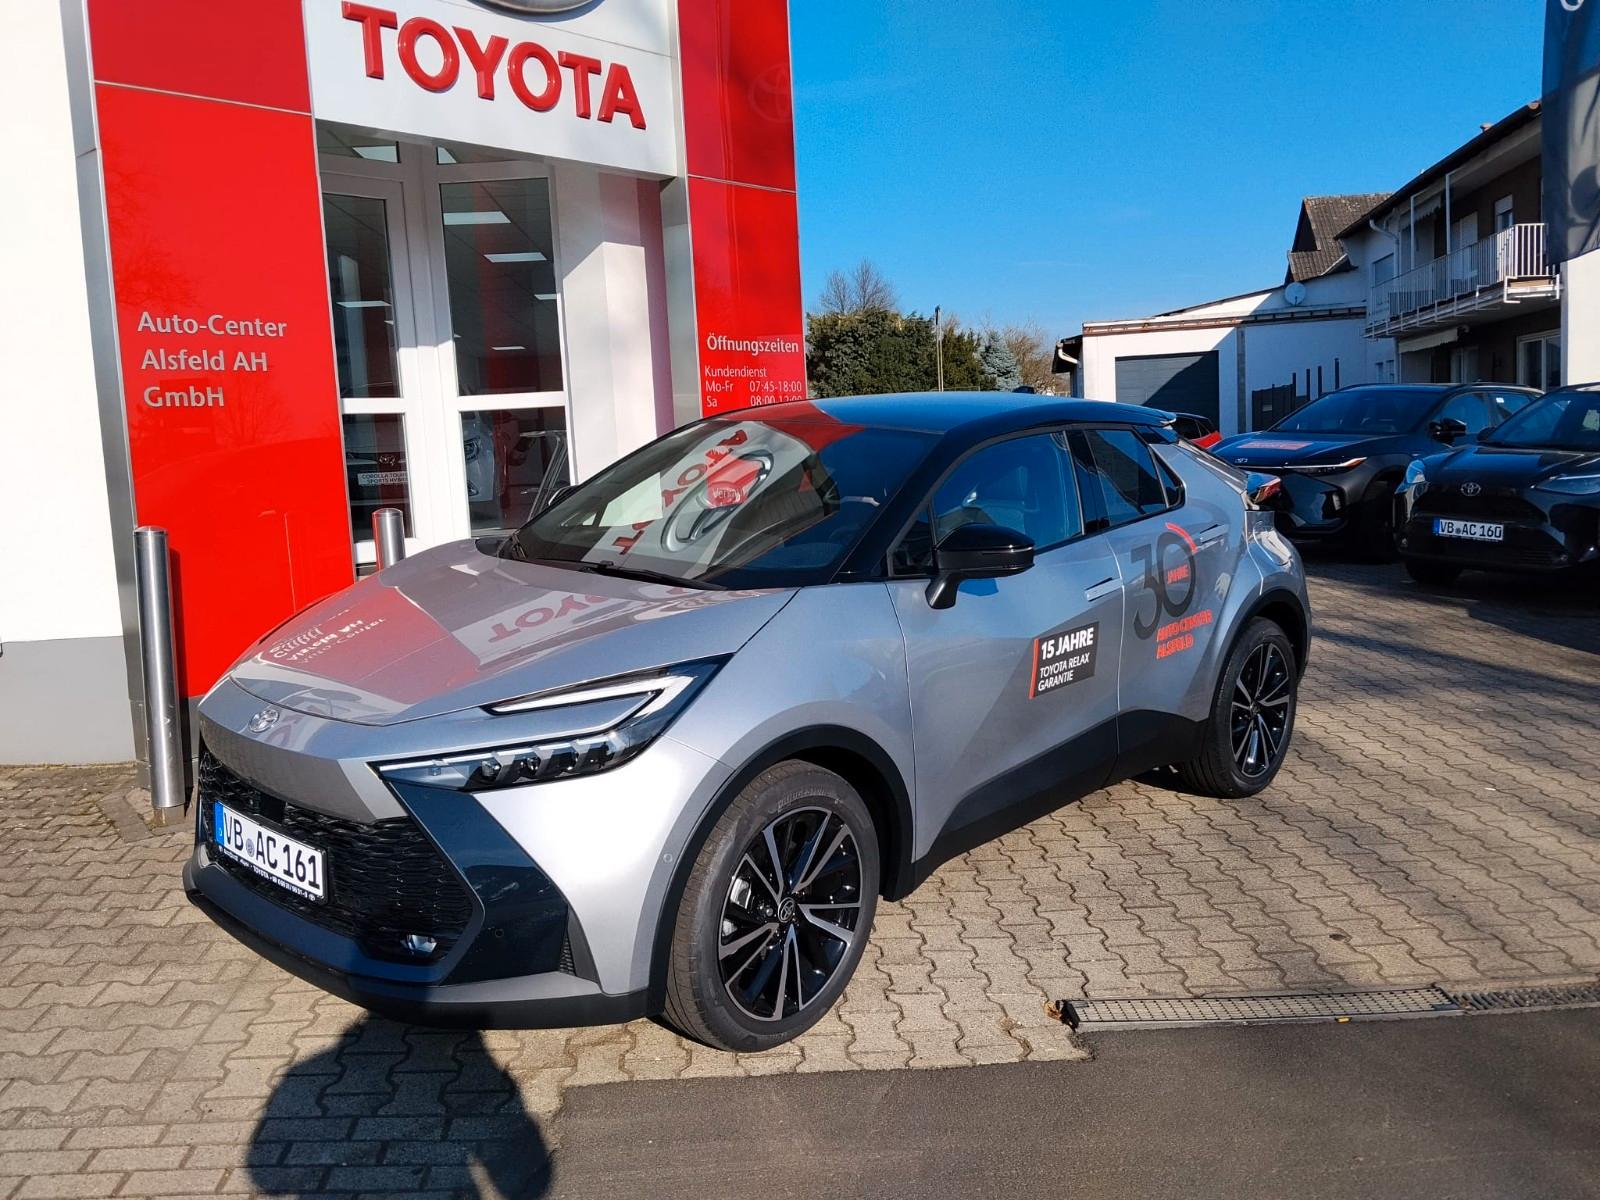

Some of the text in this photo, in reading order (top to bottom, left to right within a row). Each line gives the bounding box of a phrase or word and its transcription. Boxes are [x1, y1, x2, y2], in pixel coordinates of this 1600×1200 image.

[341, 1, 647, 130] TOYOTA
[137, 311, 287, 337] Auto-Center
[706, 332, 799, 356] Öffnungszeiten
[141, 348, 268, 372] Alsfeld AH
[705, 365, 768, 377] Kundendienst
[143, 385, 225, 408] GmbH
[705, 380, 802, 392] Mo-Fr 07:45-18:00
[706, 395, 718, 408] Sa
[1440, 521, 1455, 534] VB
[1462, 523, 1477, 536] AC
[1479, 525, 1502, 538] 160
[1130, 530, 1197, 640] 30
[1041, 628, 1095, 660] 15 JAHRE
[1040, 652, 1090, 679] TOYOTA RELAX
[1038, 670, 1075, 692] GARANTIE
[223, 812, 244, 851] VB
[256, 830, 278, 869] AC
[283, 844, 321, 890] 161
